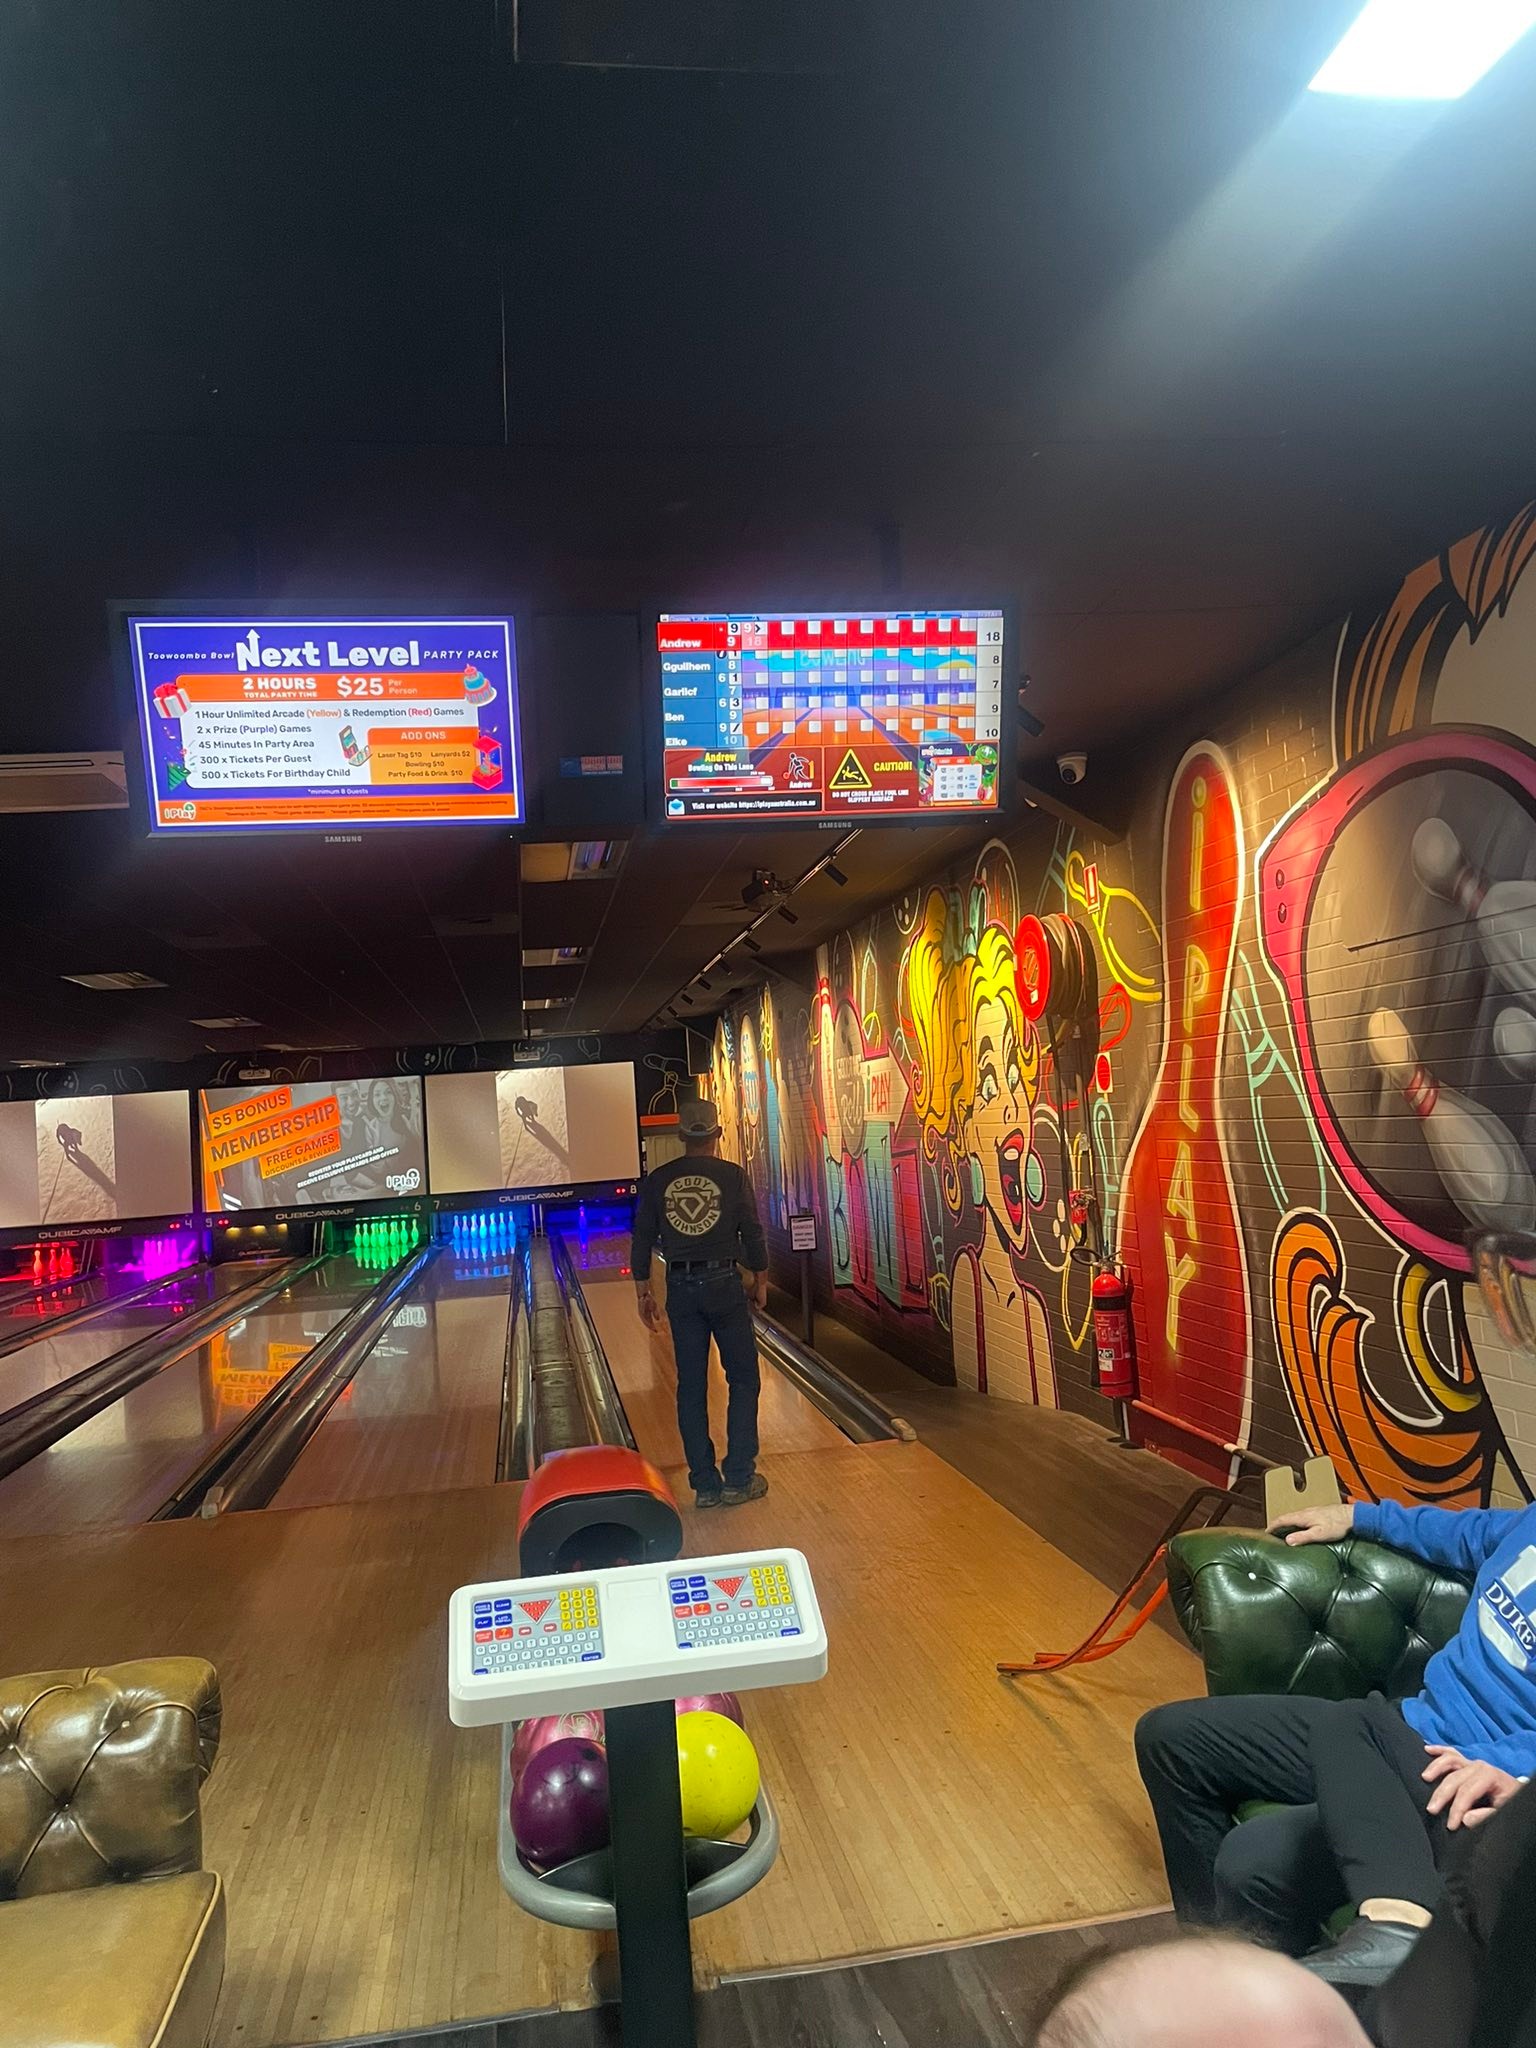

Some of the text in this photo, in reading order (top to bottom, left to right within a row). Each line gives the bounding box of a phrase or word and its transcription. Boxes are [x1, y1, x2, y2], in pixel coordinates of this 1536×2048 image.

[730, 623, 751, 633] 9 9
[660, 638, 701, 648] Andrew
[727, 636, 735, 646] 9
[986, 632, 1000, 641] 18
[148, 652, 234, 660] Toowoomba Bowl
[236, 631, 420, 671] Next Level
[424, 650, 499, 659] PARTY PACK
[728, 656, 999, 670] 8 8
[718, 674, 737, 682] 6 1
[243, 677, 316, 690] 2 HOURS
[336, 675, 384, 698] $25
[729, 686, 735, 695] 7
[993, 680, 999, 688] 7
[388, 687, 418, 695] Person
[719, 698, 739, 707] 6 3
[226, 710, 270, 718] Unlimited
[272, 710, 305, 718] Arcade
[306, 709, 342, 718] (Yellow)
[343, 709, 350, 717] &
[353, 709, 407, 718] Redemption
[408, 708, 432, 716] (Red)
[434, 708, 464, 716] Games
[664, 704, 998, 721] Ben 9 9
[197, 726, 202, 734] 2
[213, 725, 237, 733] Prize
[239, 725, 277, 735] (Purple)
[279, 725, 312, 733] Games
[720, 723, 726, 732] 9
[401, 731, 446, 740] ADD ONS
[665, 729, 998, 746] Elke 10 10
[199, 741, 211, 749] 45
[265, 740, 291, 749] Party
[200, 756, 219, 764] 300
[704, 752, 737, 762] Andrew
[808, 760, 814, 779] 1
[873, 761, 912, 771] CAUTION!
[201, 771, 220, 779] 500
[230, 770, 265, 779] Tickets
[267, 770, 282, 778] For
[285, 770, 325, 779] Birthday
[327, 769, 351, 777] Child
[692, 802, 705, 810] Visit
[717, 801, 737, 809] website
[212, 1093, 287, 1129] $5 BONUS
[211, 1104, 335, 1162] MEMBERSHIP
[266, 1134, 334, 1166] FREE GAMES
[265, 1158, 301, 1176] DISCOUNTS
[310, 1144, 341, 1159] REWARDS
[394, 1174, 420, 1188] Play
[674, 1177, 711, 1190] CODY
[630, 1185, 637, 1194] 8
[414, 1202, 421, 1210] 6
[434, 1201, 440, 1209] 7
[185, 1218, 192, 1228] 4
[668, 1211, 718, 1234] JOHNSON
[1486, 1582, 1536, 1650] DUKE
